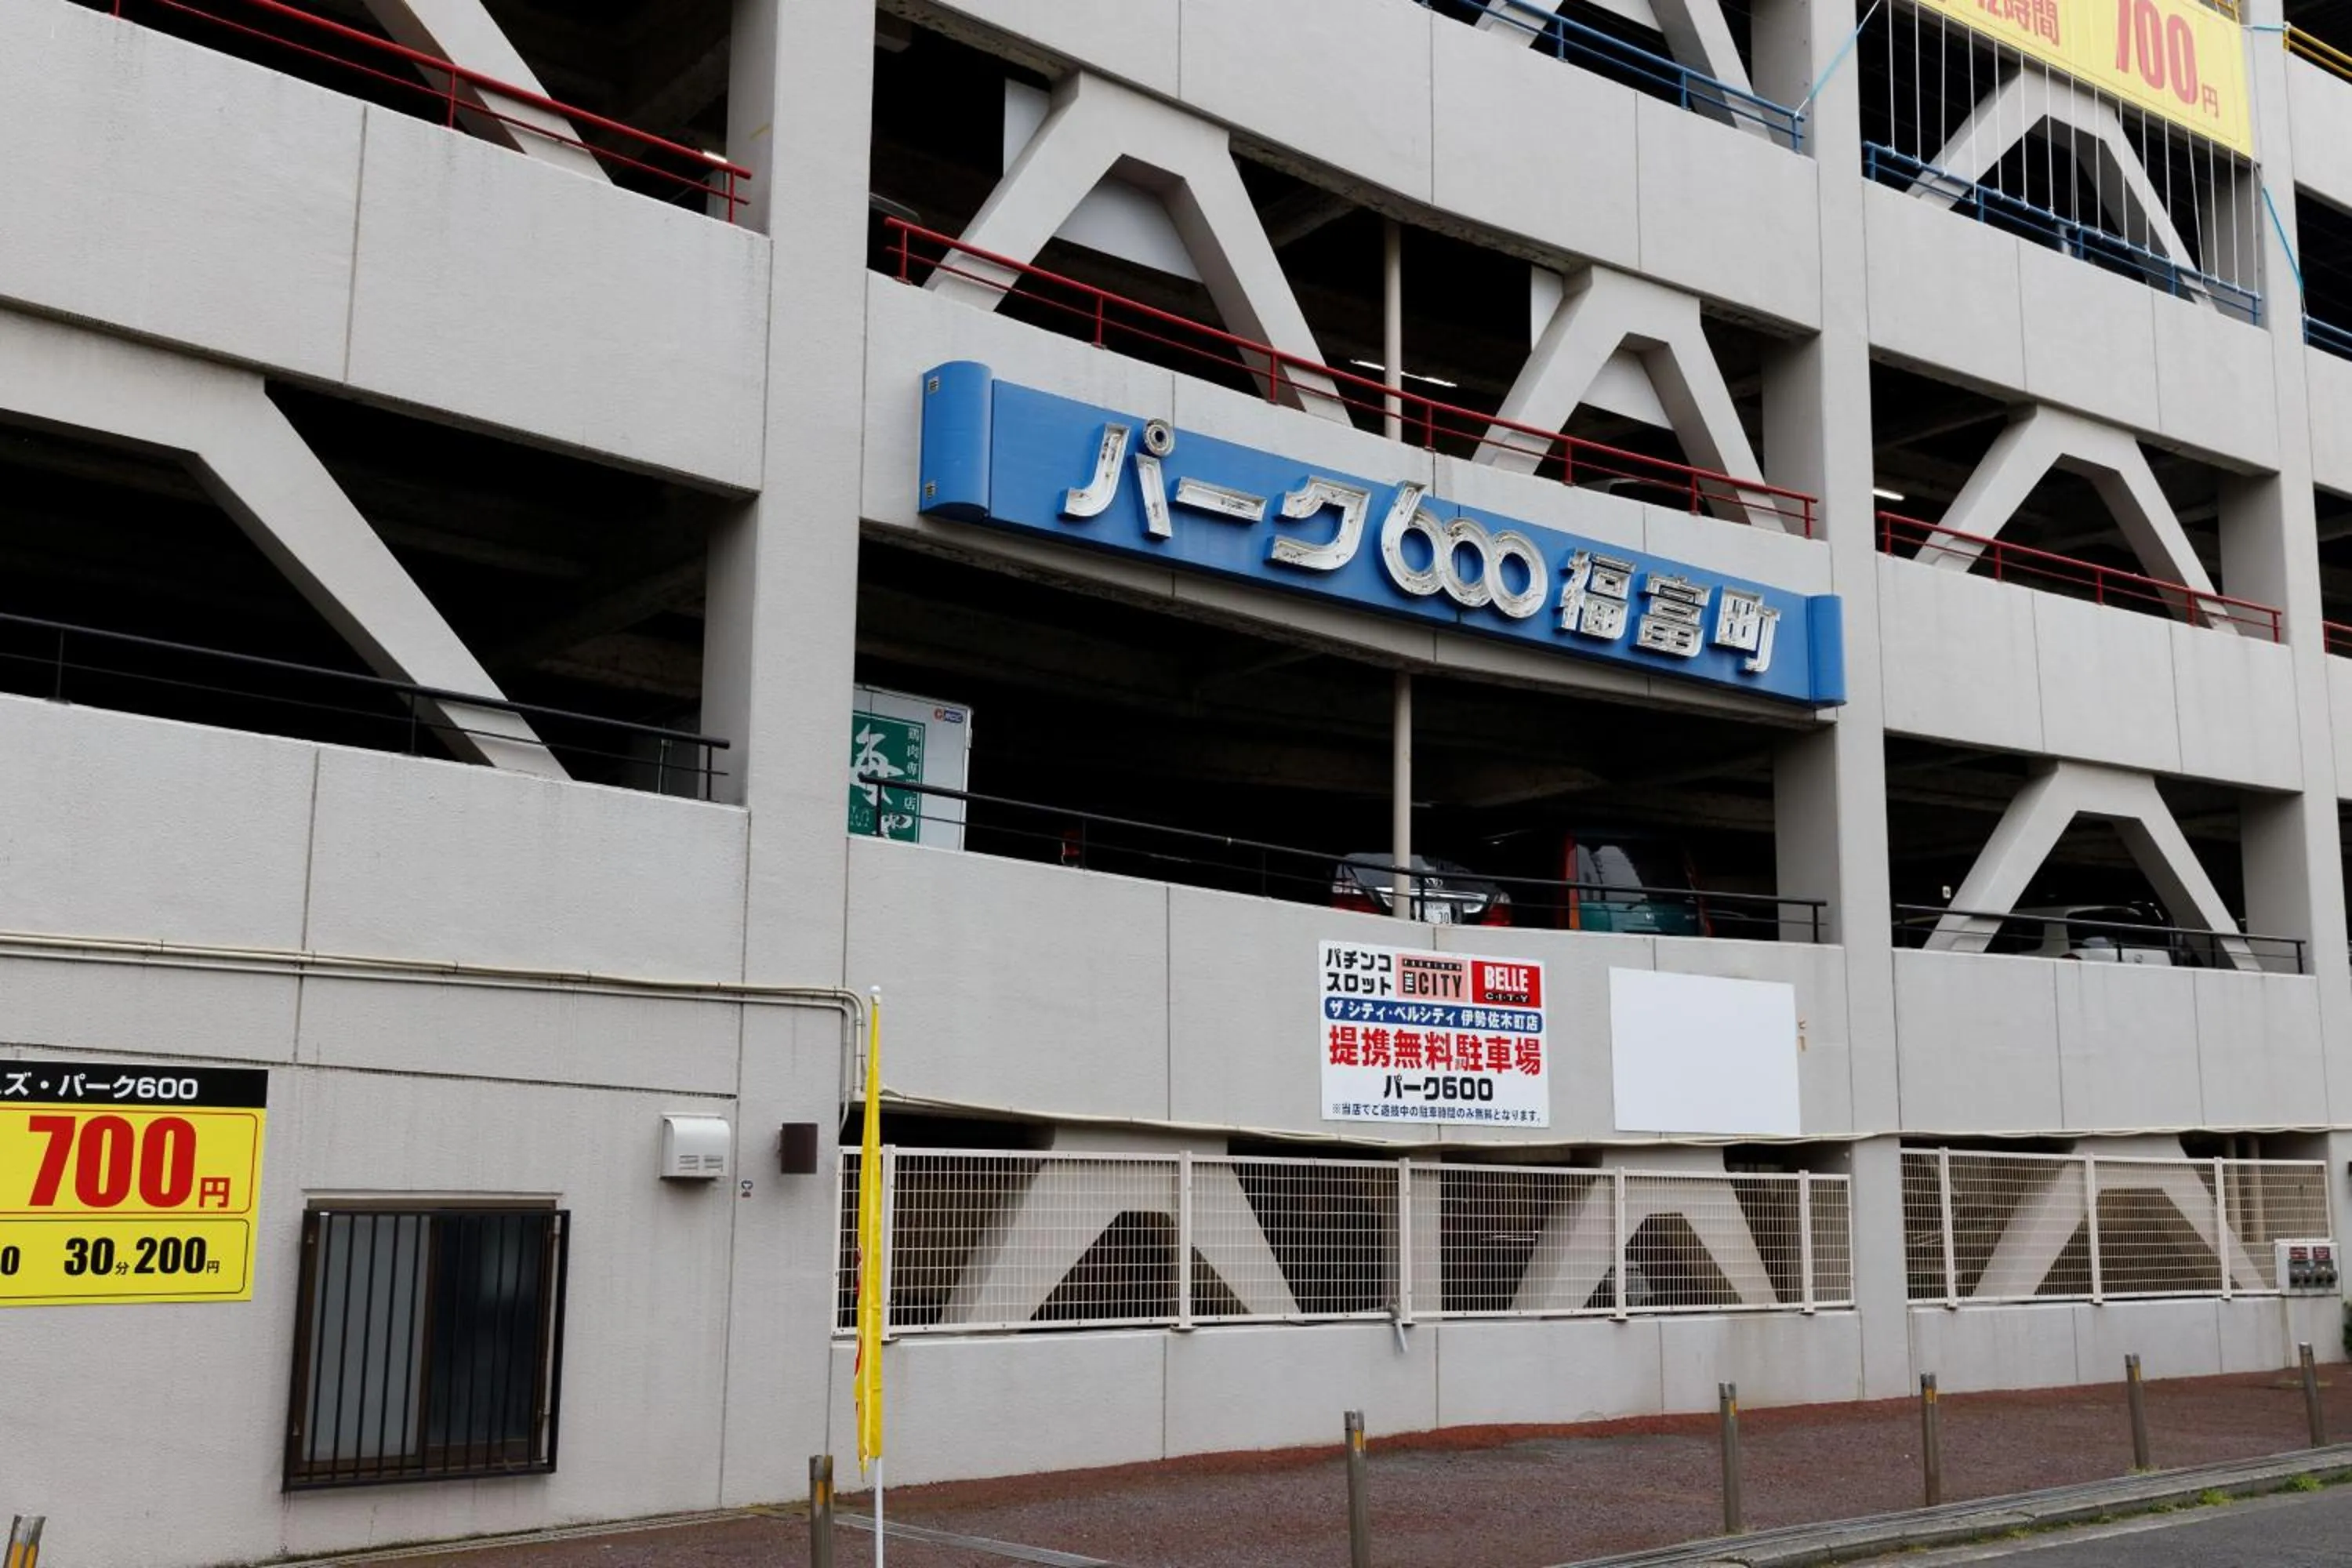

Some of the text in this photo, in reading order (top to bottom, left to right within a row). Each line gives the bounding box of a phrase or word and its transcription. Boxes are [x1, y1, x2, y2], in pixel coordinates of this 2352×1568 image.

[1061, 419, 1780, 674] パーク600福富町
[1327, 948, 1392, 972] パチンコ
[1327, 972, 1392, 996] スロット
[1404, 972, 1462, 998] THE CITY
[1484, 965, 1529, 993] BELLE
[1330, 1000, 1539, 1032] ザ シティ・ベルシティ 伊勢佐木町店
[1329, 1025, 1541, 1076] 提携無料駐車場
[0, 1072, 198, 1099] ズ・パーク600
[1384, 1074, 1494, 1102] パーク600
[28, 1115, 230, 1208] 700円
